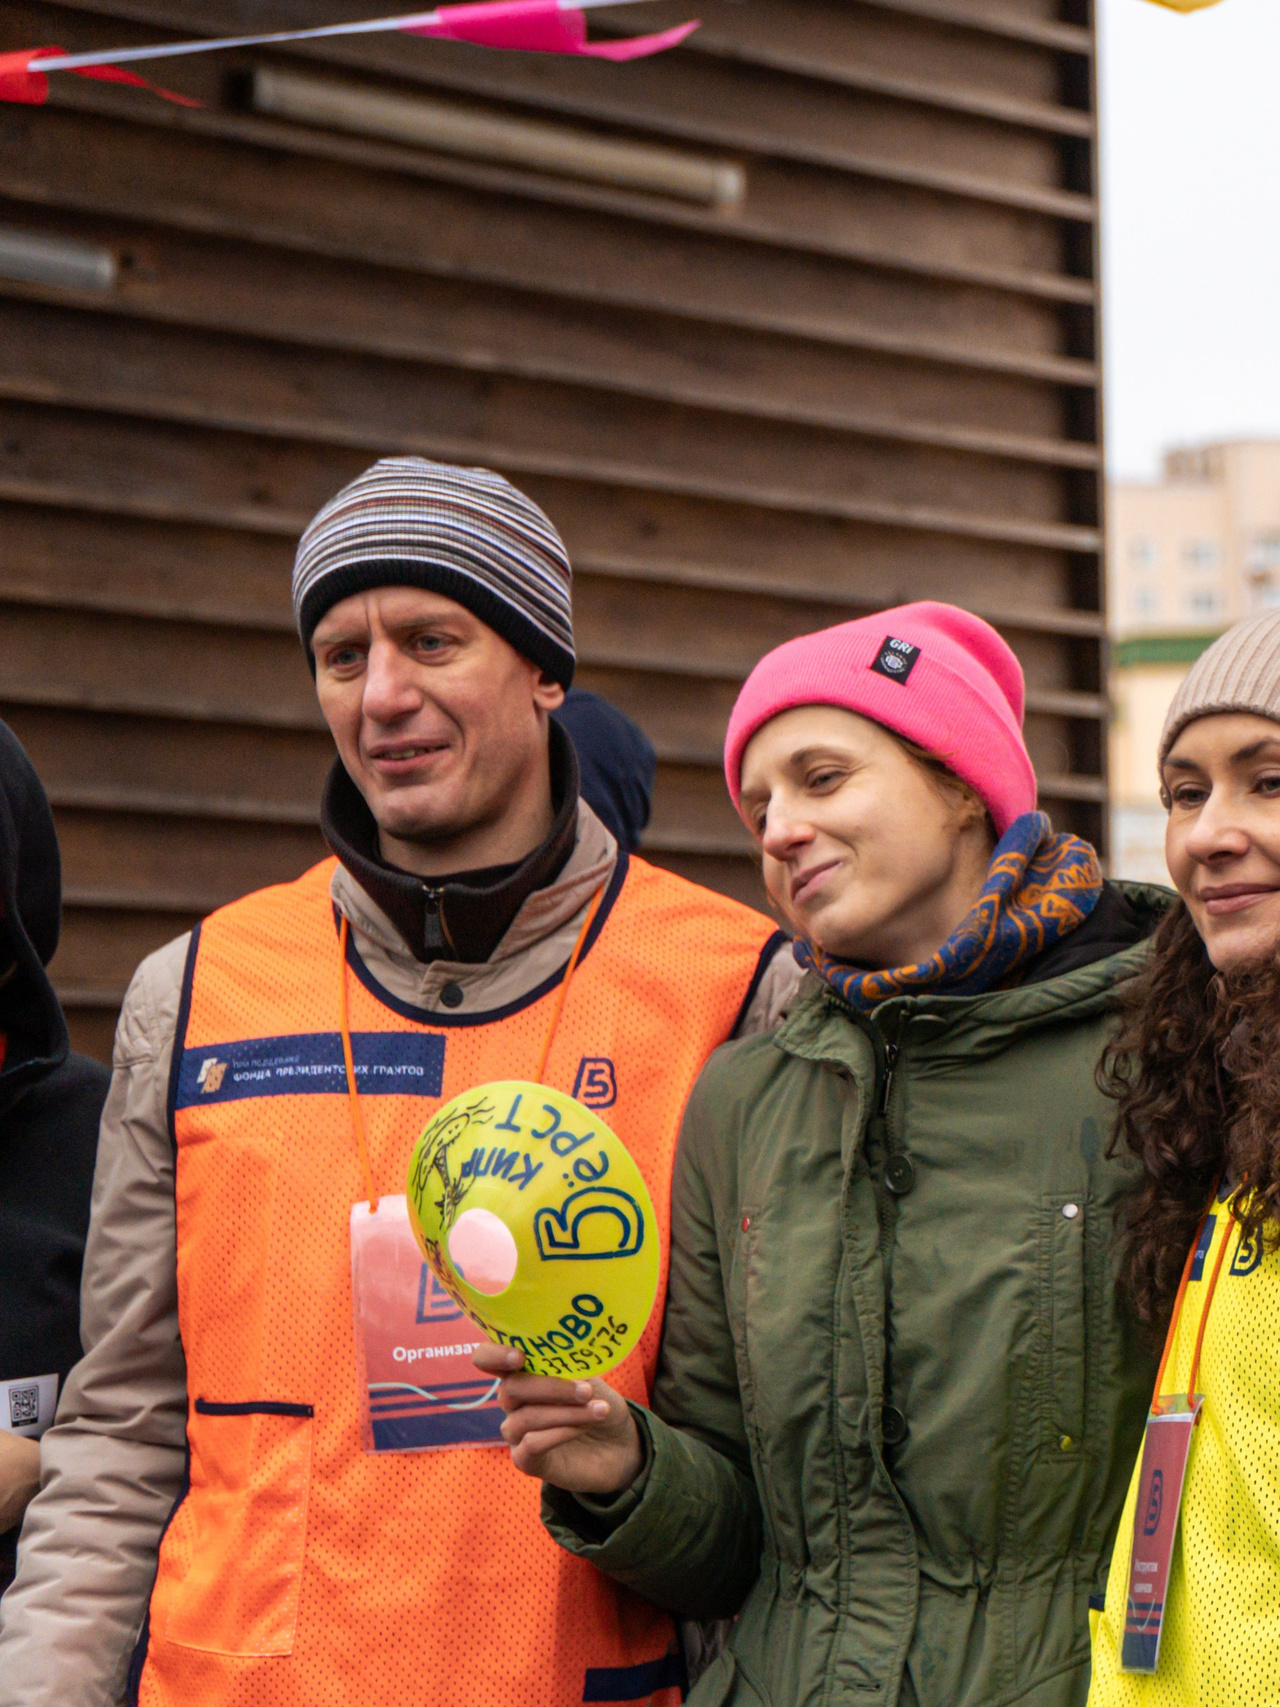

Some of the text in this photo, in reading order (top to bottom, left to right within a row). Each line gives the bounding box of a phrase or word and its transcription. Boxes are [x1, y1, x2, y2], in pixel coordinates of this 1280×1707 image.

[233, 1064, 425, 1083] ФОНДА ПРЕЗИДЕНТСИХ ГРАНТОВ
